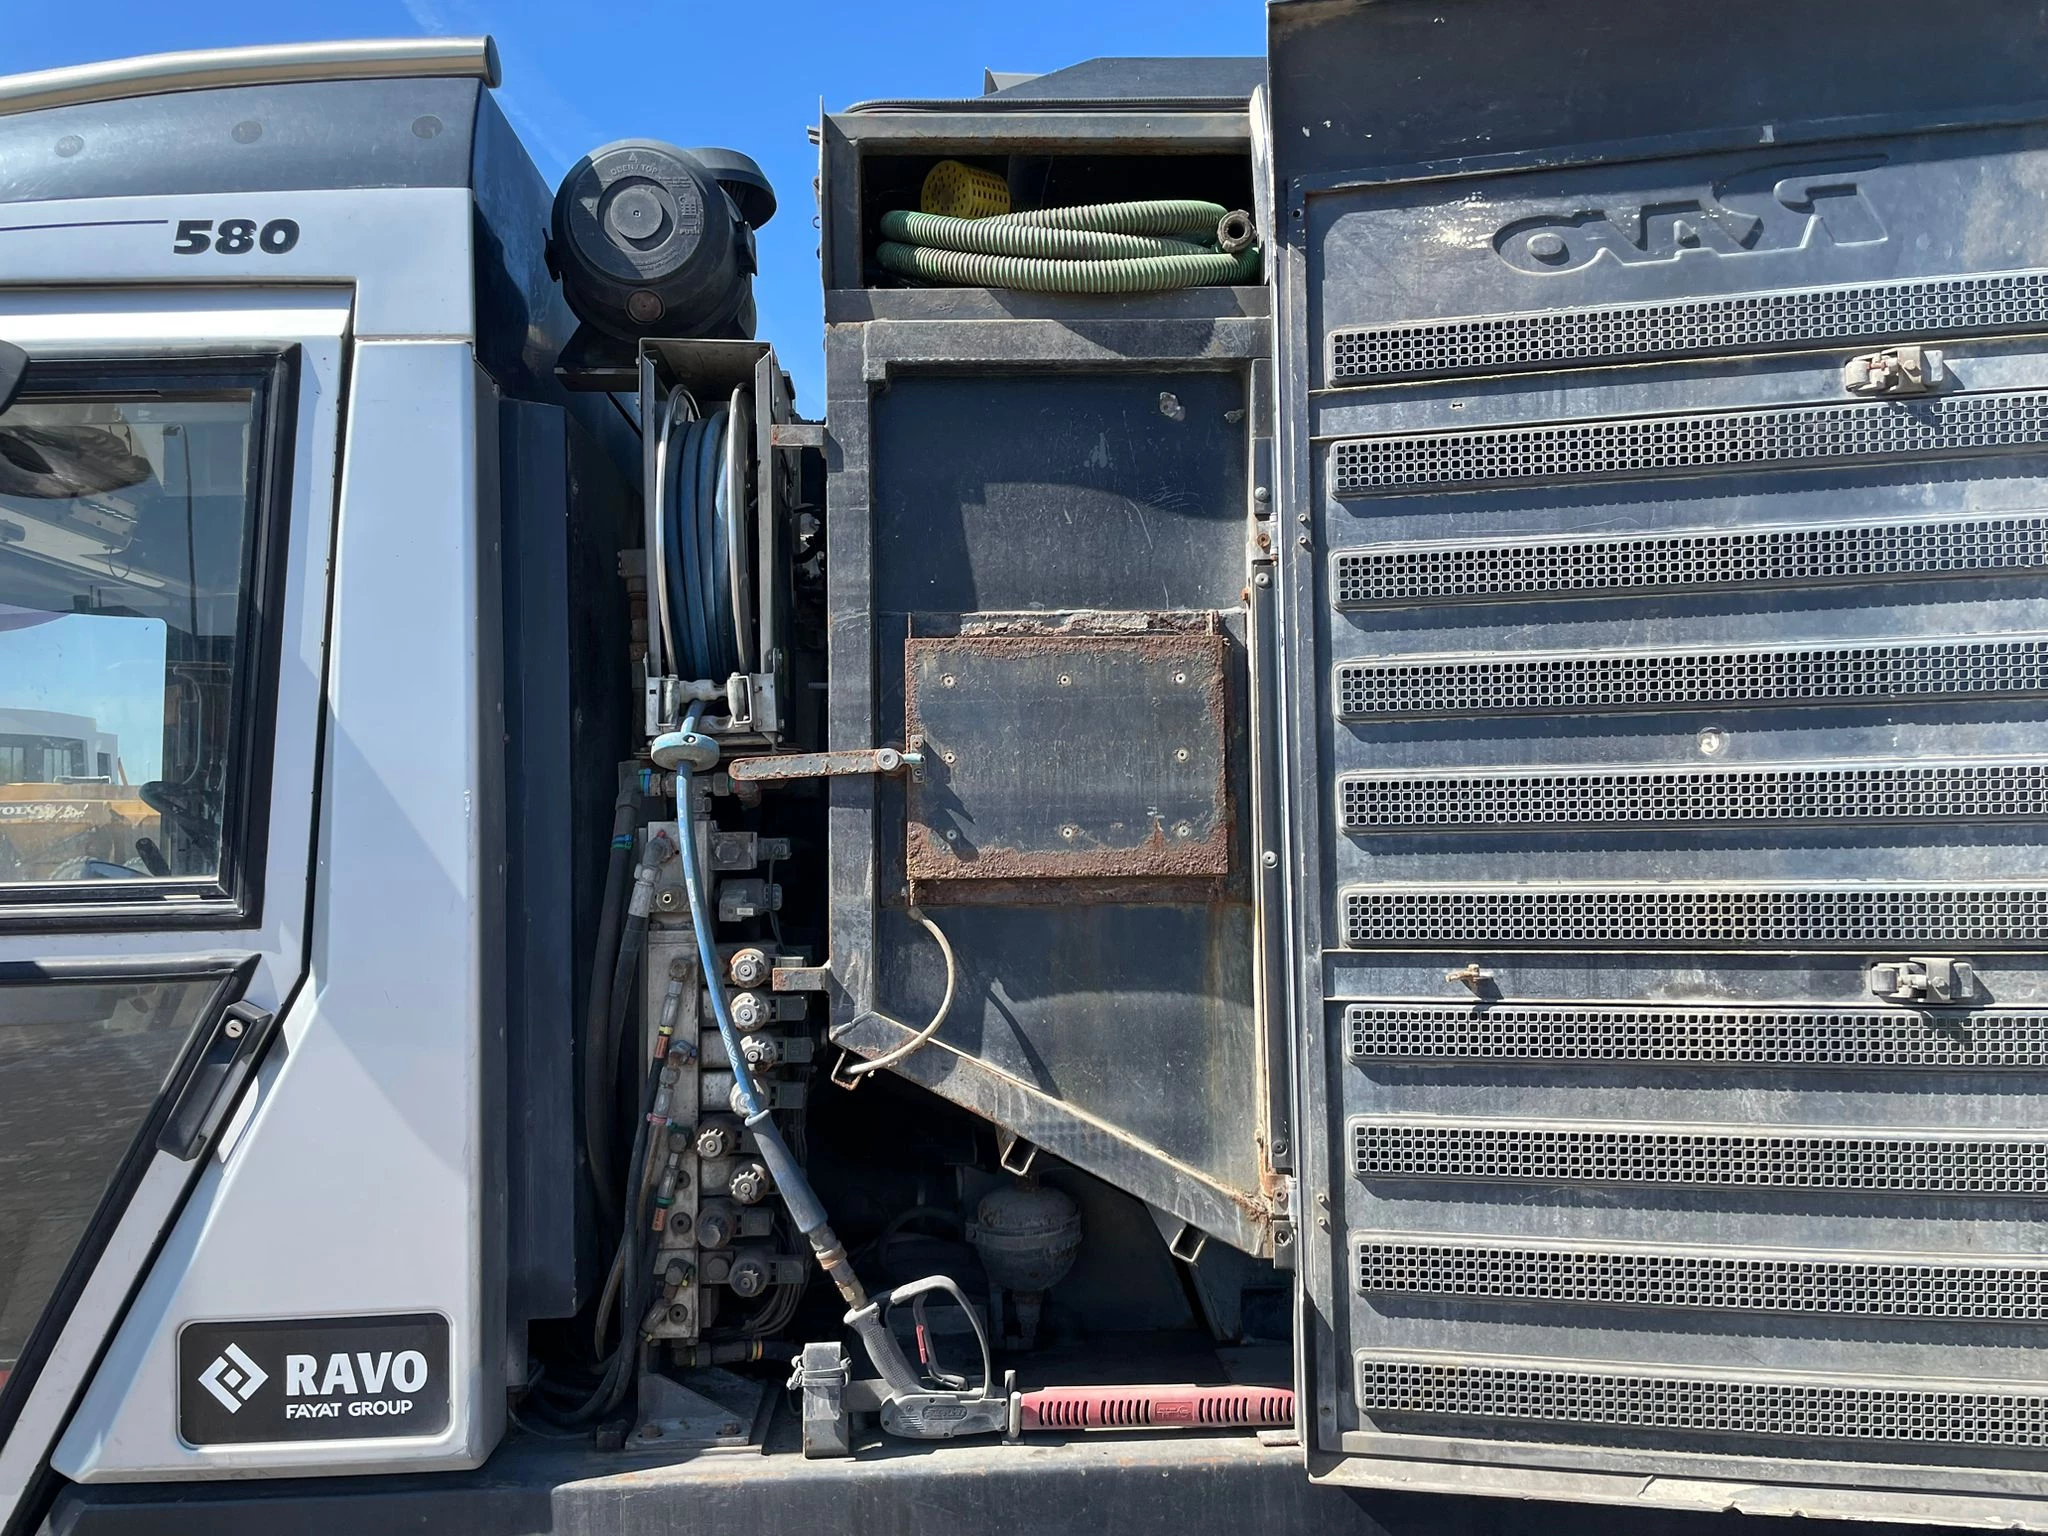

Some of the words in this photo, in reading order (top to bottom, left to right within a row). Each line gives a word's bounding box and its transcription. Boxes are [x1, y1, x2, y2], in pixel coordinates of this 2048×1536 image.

[173, 218, 300, 255] 580
[286, 1350, 428, 1396] RAVO
[286, 1402, 342, 1419] FAYAT
[348, 1399, 413, 1417] GROUP
